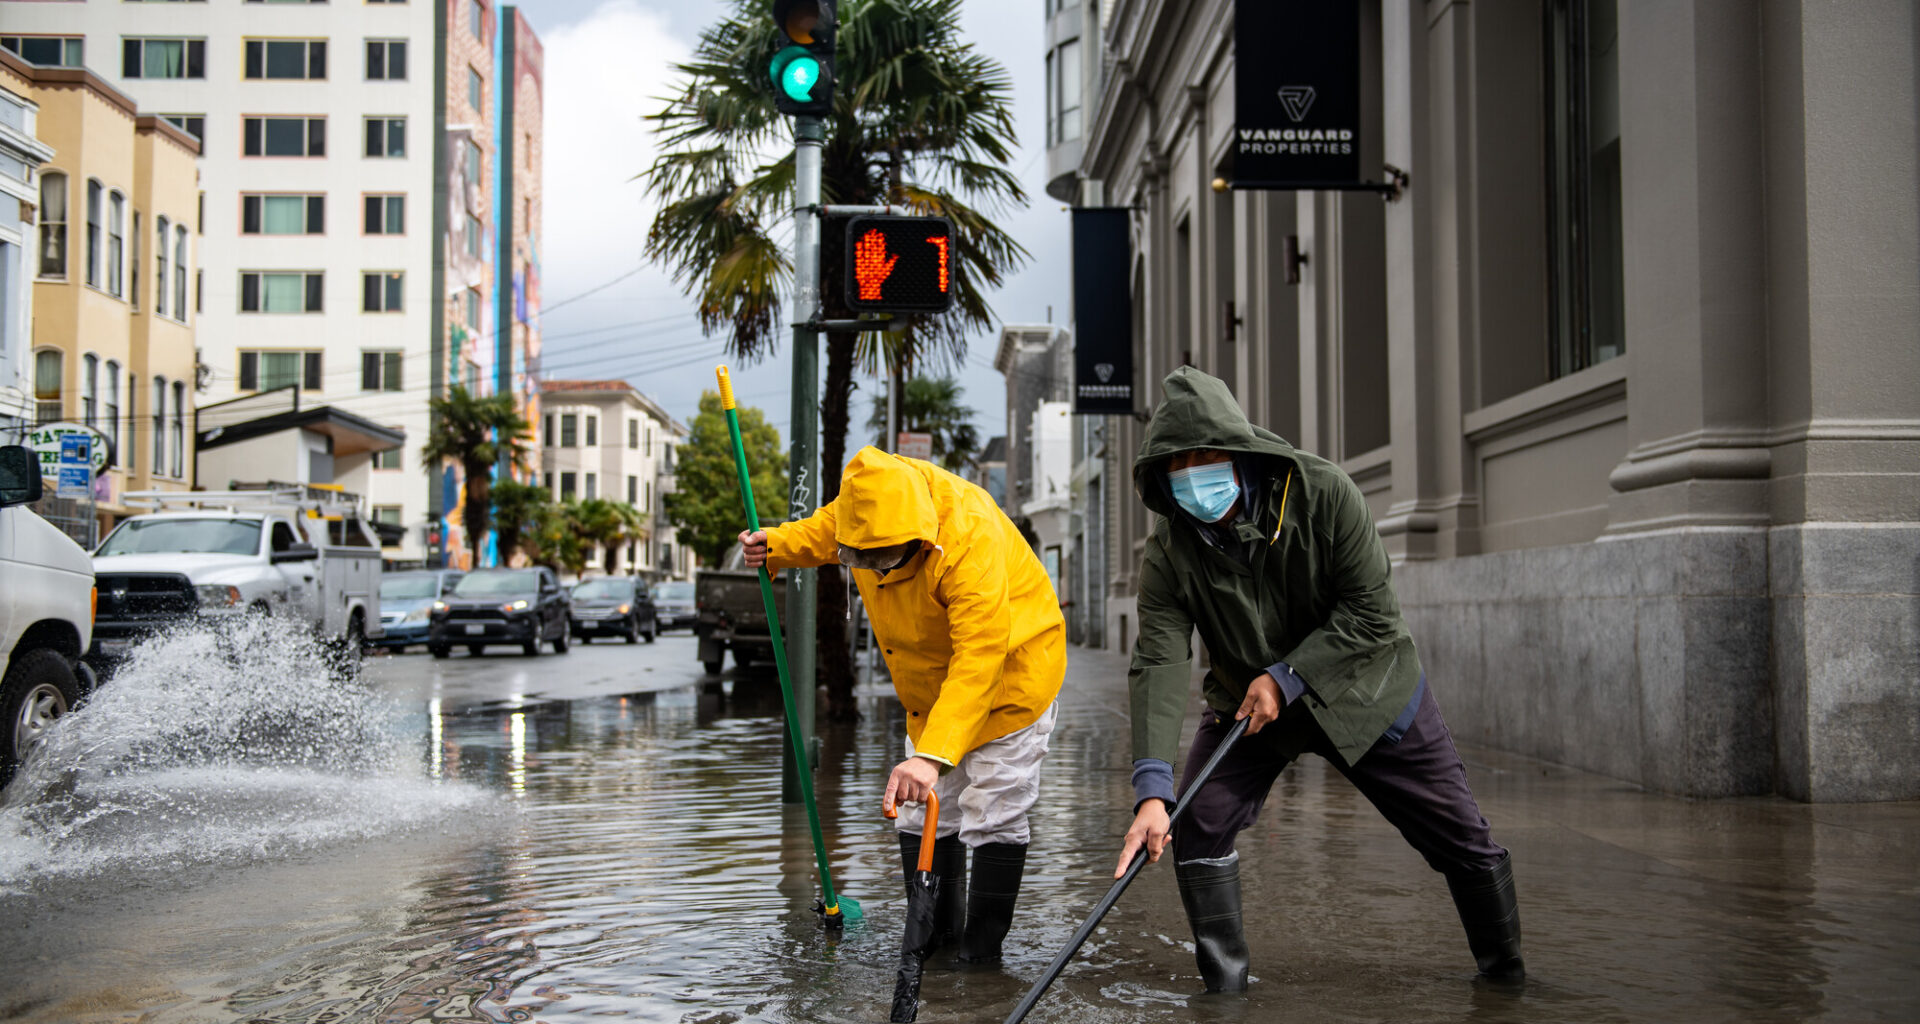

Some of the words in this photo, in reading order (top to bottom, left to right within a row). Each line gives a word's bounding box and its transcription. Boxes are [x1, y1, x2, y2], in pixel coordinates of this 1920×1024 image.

[1239, 129, 1353, 141] VANGUARD
[1239, 142, 1352, 155] PROPERTIES
[925, 235, 950, 293] 7
[30, 429, 101, 447] TATO
